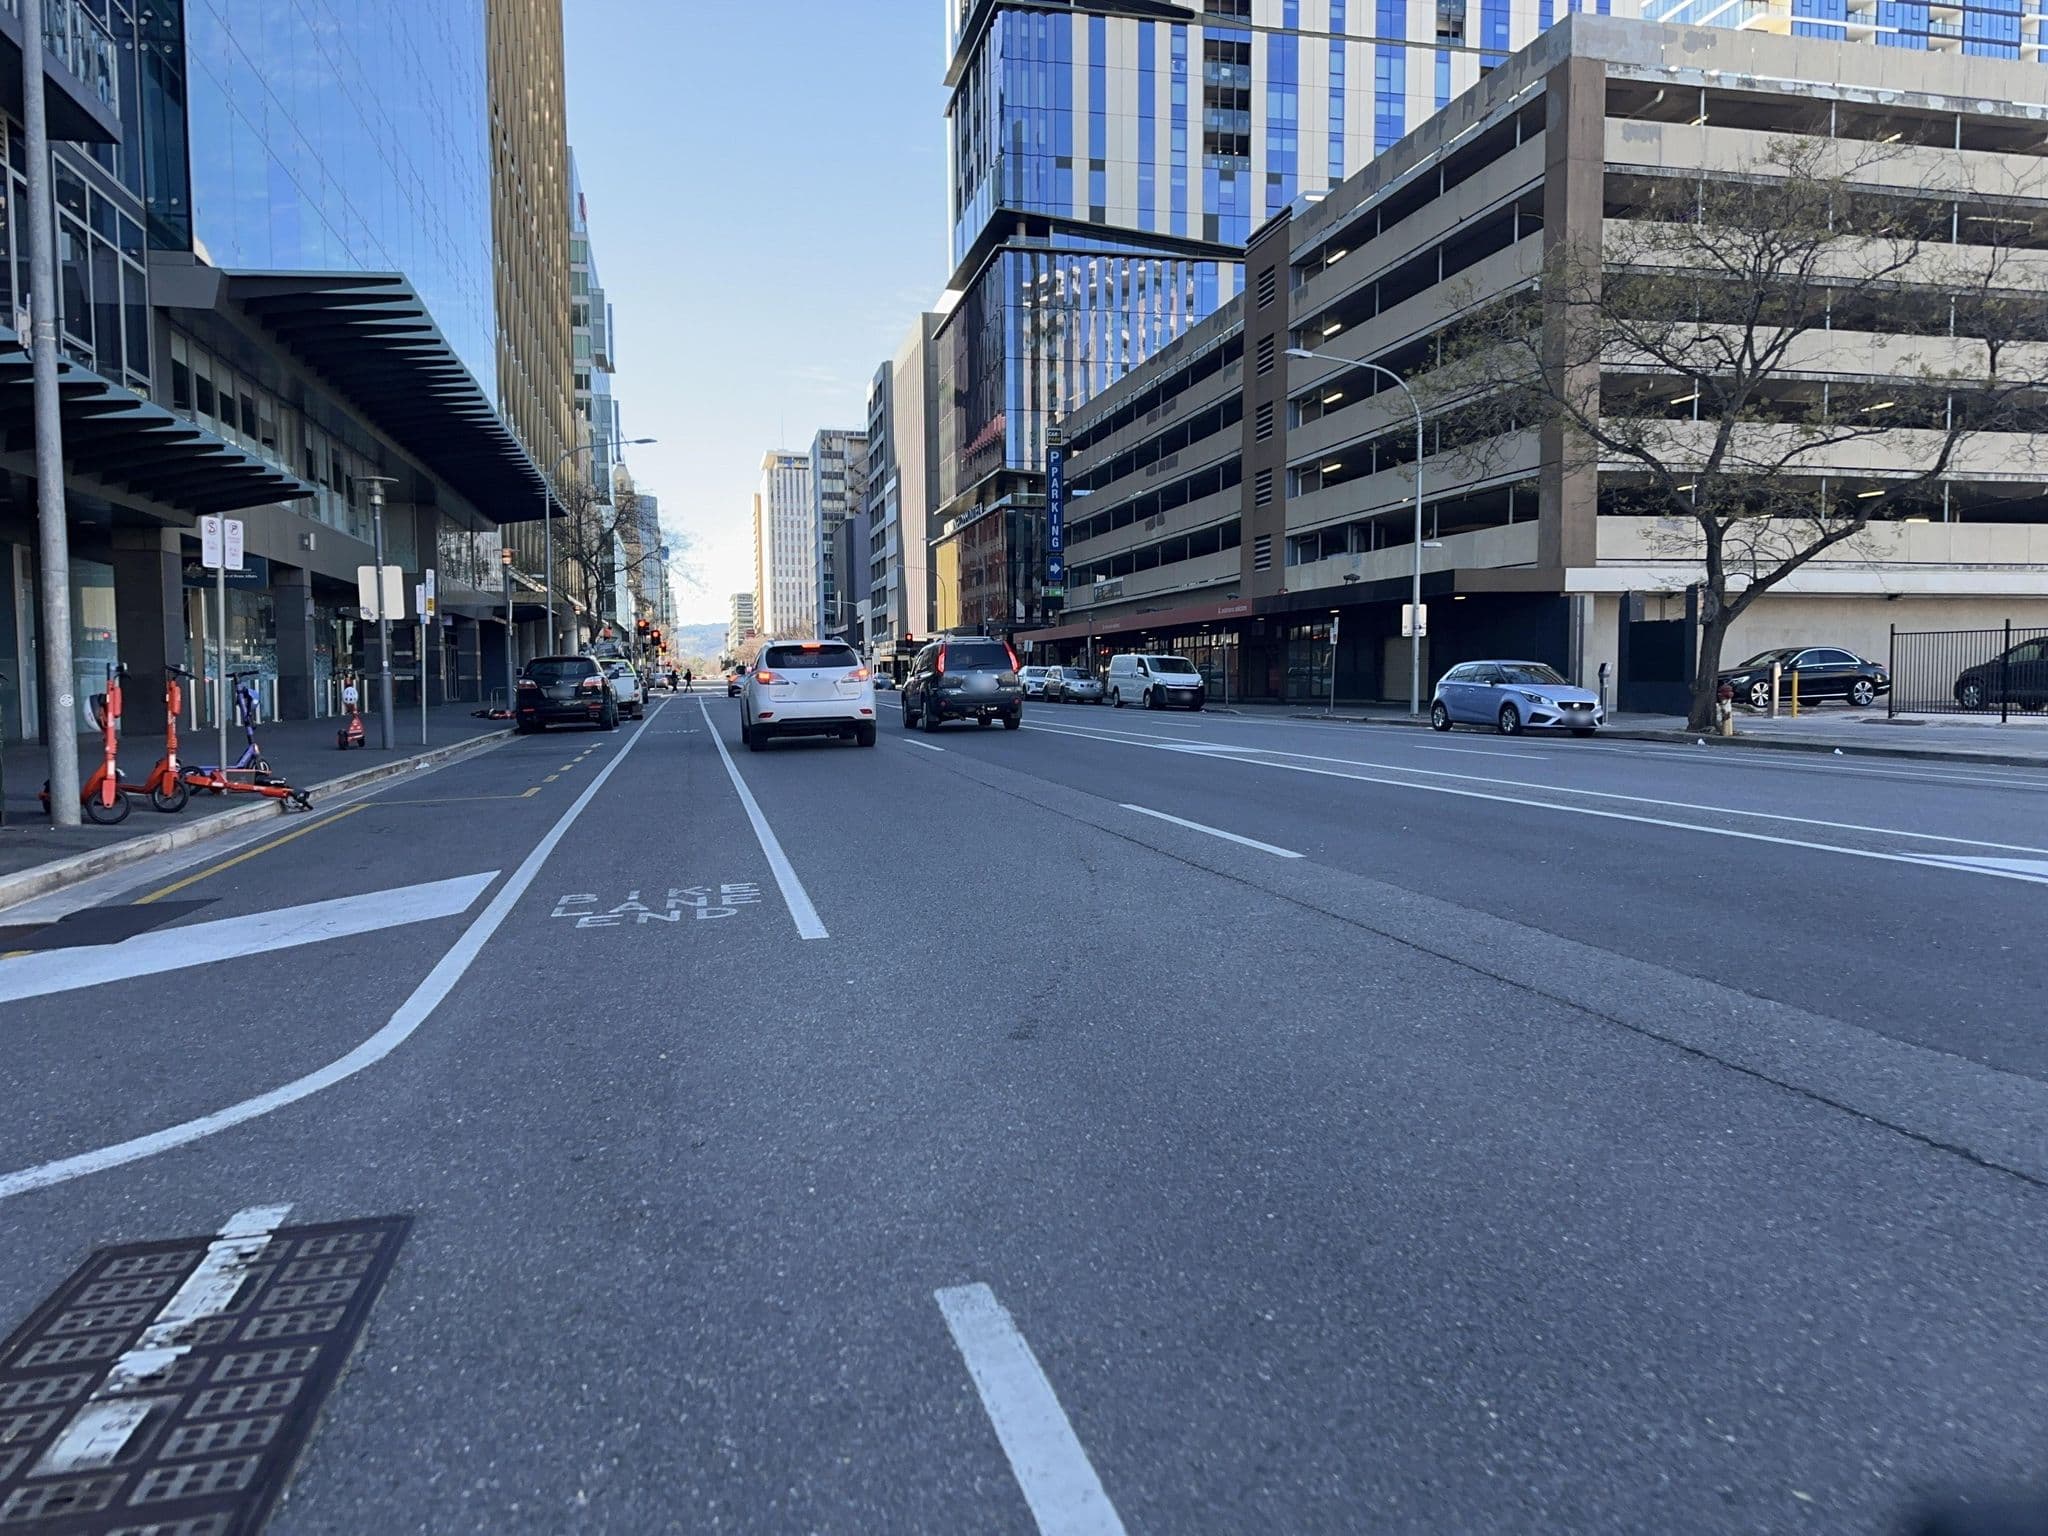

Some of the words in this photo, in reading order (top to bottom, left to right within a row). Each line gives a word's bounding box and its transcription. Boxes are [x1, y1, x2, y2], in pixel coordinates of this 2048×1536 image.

[1050, 451, 1060, 463] P
[1051, 467, 1059, 547] PARKING
[574, 907, 738, 928] END
